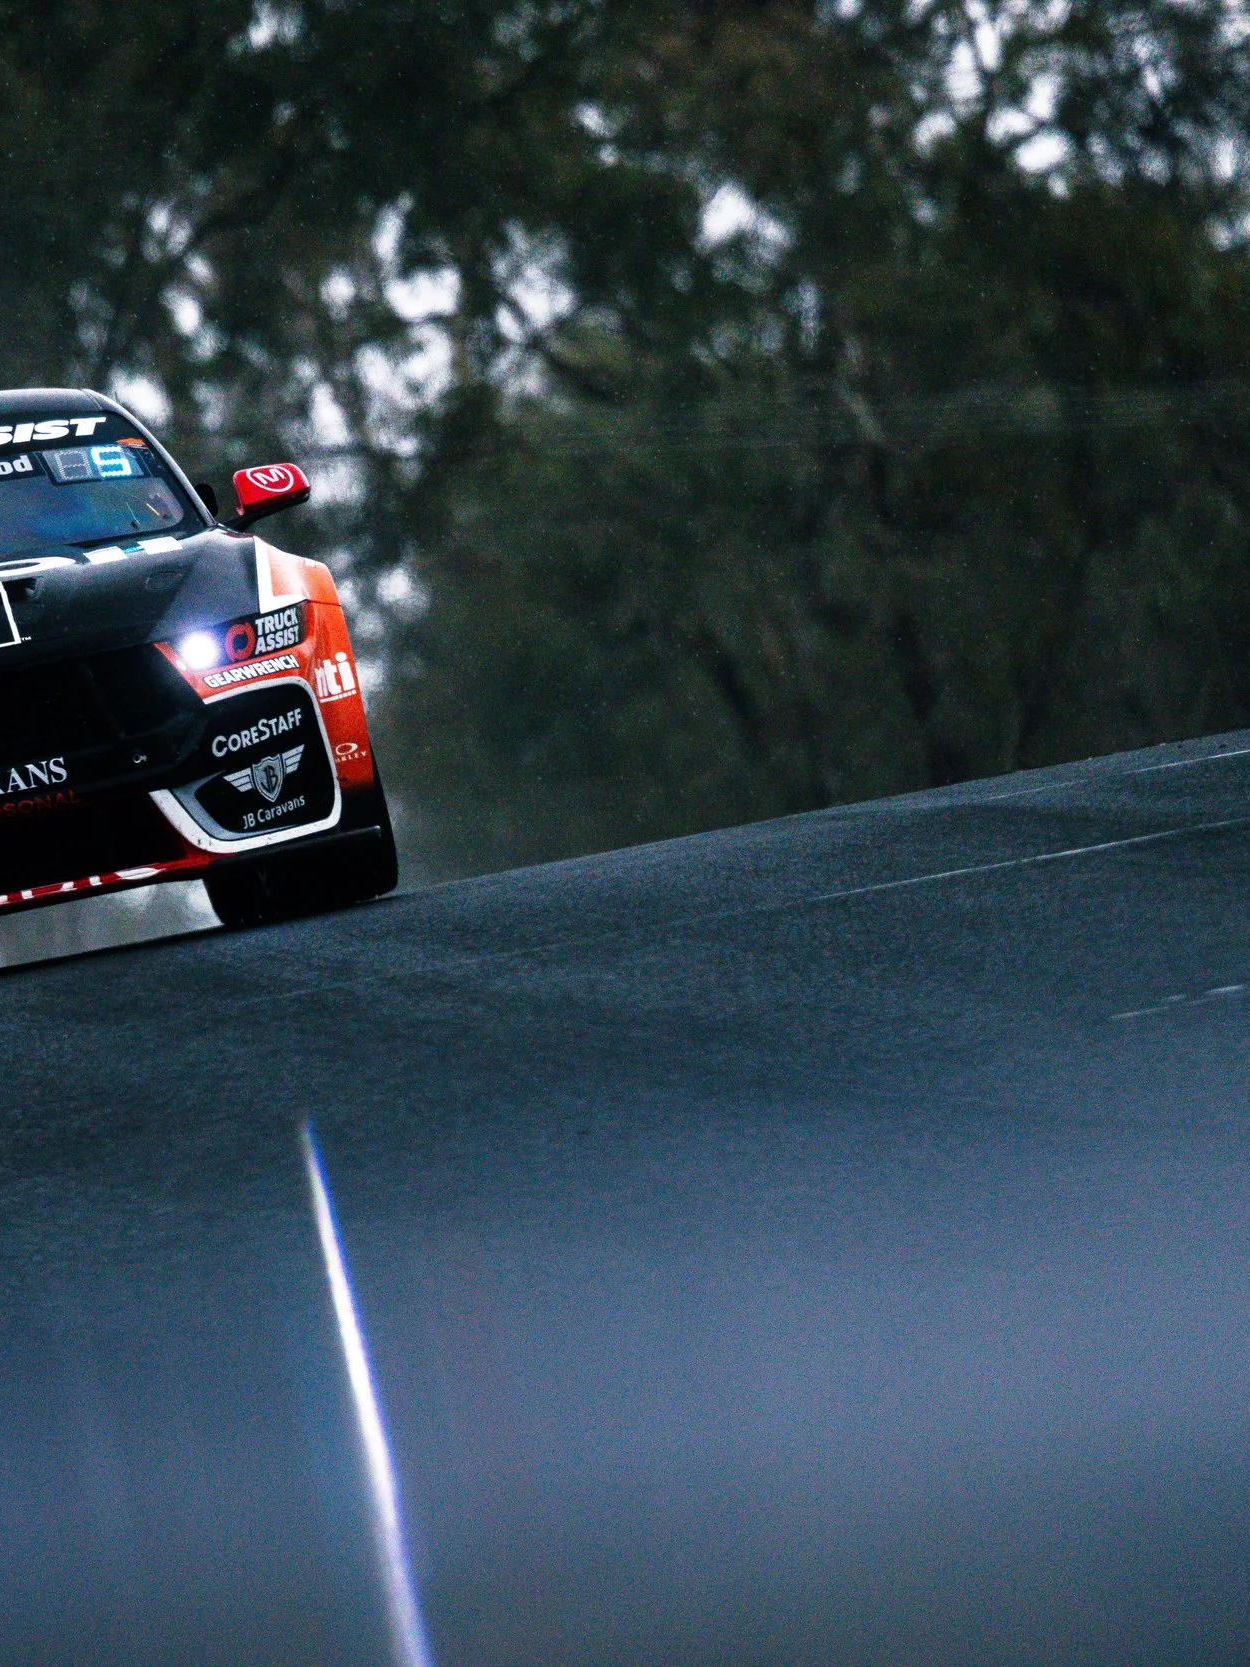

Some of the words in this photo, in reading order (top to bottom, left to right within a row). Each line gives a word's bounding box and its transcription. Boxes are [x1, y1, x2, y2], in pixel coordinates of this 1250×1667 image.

[254, 607, 298, 634] TRUCK
[255, 625, 299, 655] ASSIST
[203, 654, 300, 688] GEARWRENCH
[243, 814, 255, 829] JB
[257, 795, 306, 823] Caravans
